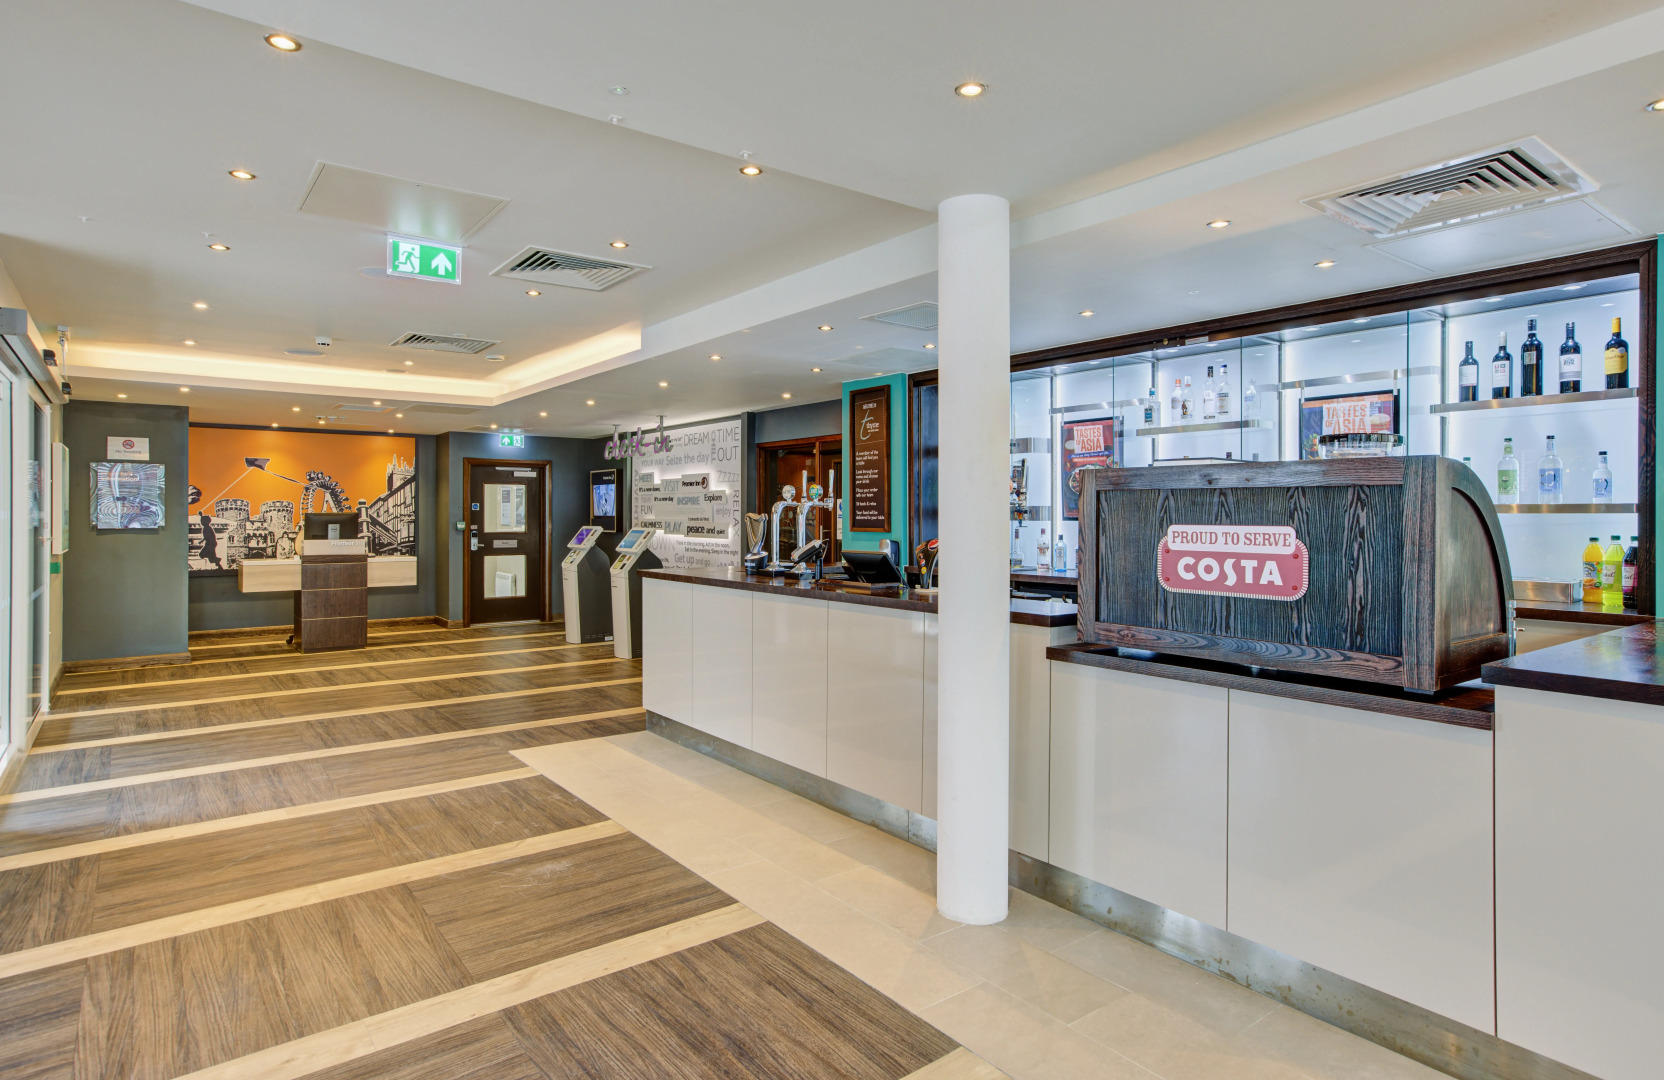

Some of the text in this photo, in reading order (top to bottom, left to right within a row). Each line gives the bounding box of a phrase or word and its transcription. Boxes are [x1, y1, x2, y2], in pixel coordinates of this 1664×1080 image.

[1326, 404, 1367, 419] TASTES
[1075, 427, 1101, 439] TASTES
[1332, 418, 1367, 434] ASIA
[684, 432, 710, 446] DREAM
[716, 427, 740, 442] TIME
[604, 424, 674, 460] check-in
[1081, 438, 1102, 452] ASIA
[666, 454, 682, 466] Seize
[684, 452, 695, 463] the
[696, 452, 710, 465] day
[718, 446, 739, 462] OUT
[664, 481, 680, 492] VISIT
[677, 496, 700, 505] INSPIRE
[704, 494, 722, 503] Explore
[641, 505, 652, 514] FUN
[716, 507, 731, 517] enjoy
[664, 521, 682, 532] PLAY
[687, 526, 705, 535] peace
[1172, 531, 1291, 547] PROUD TO SERVE
[674, 553, 685, 563] Get
[687, 556, 694, 566] up
[704, 559, 710, 567] go
[1177, 556, 1283, 586] COSTA
